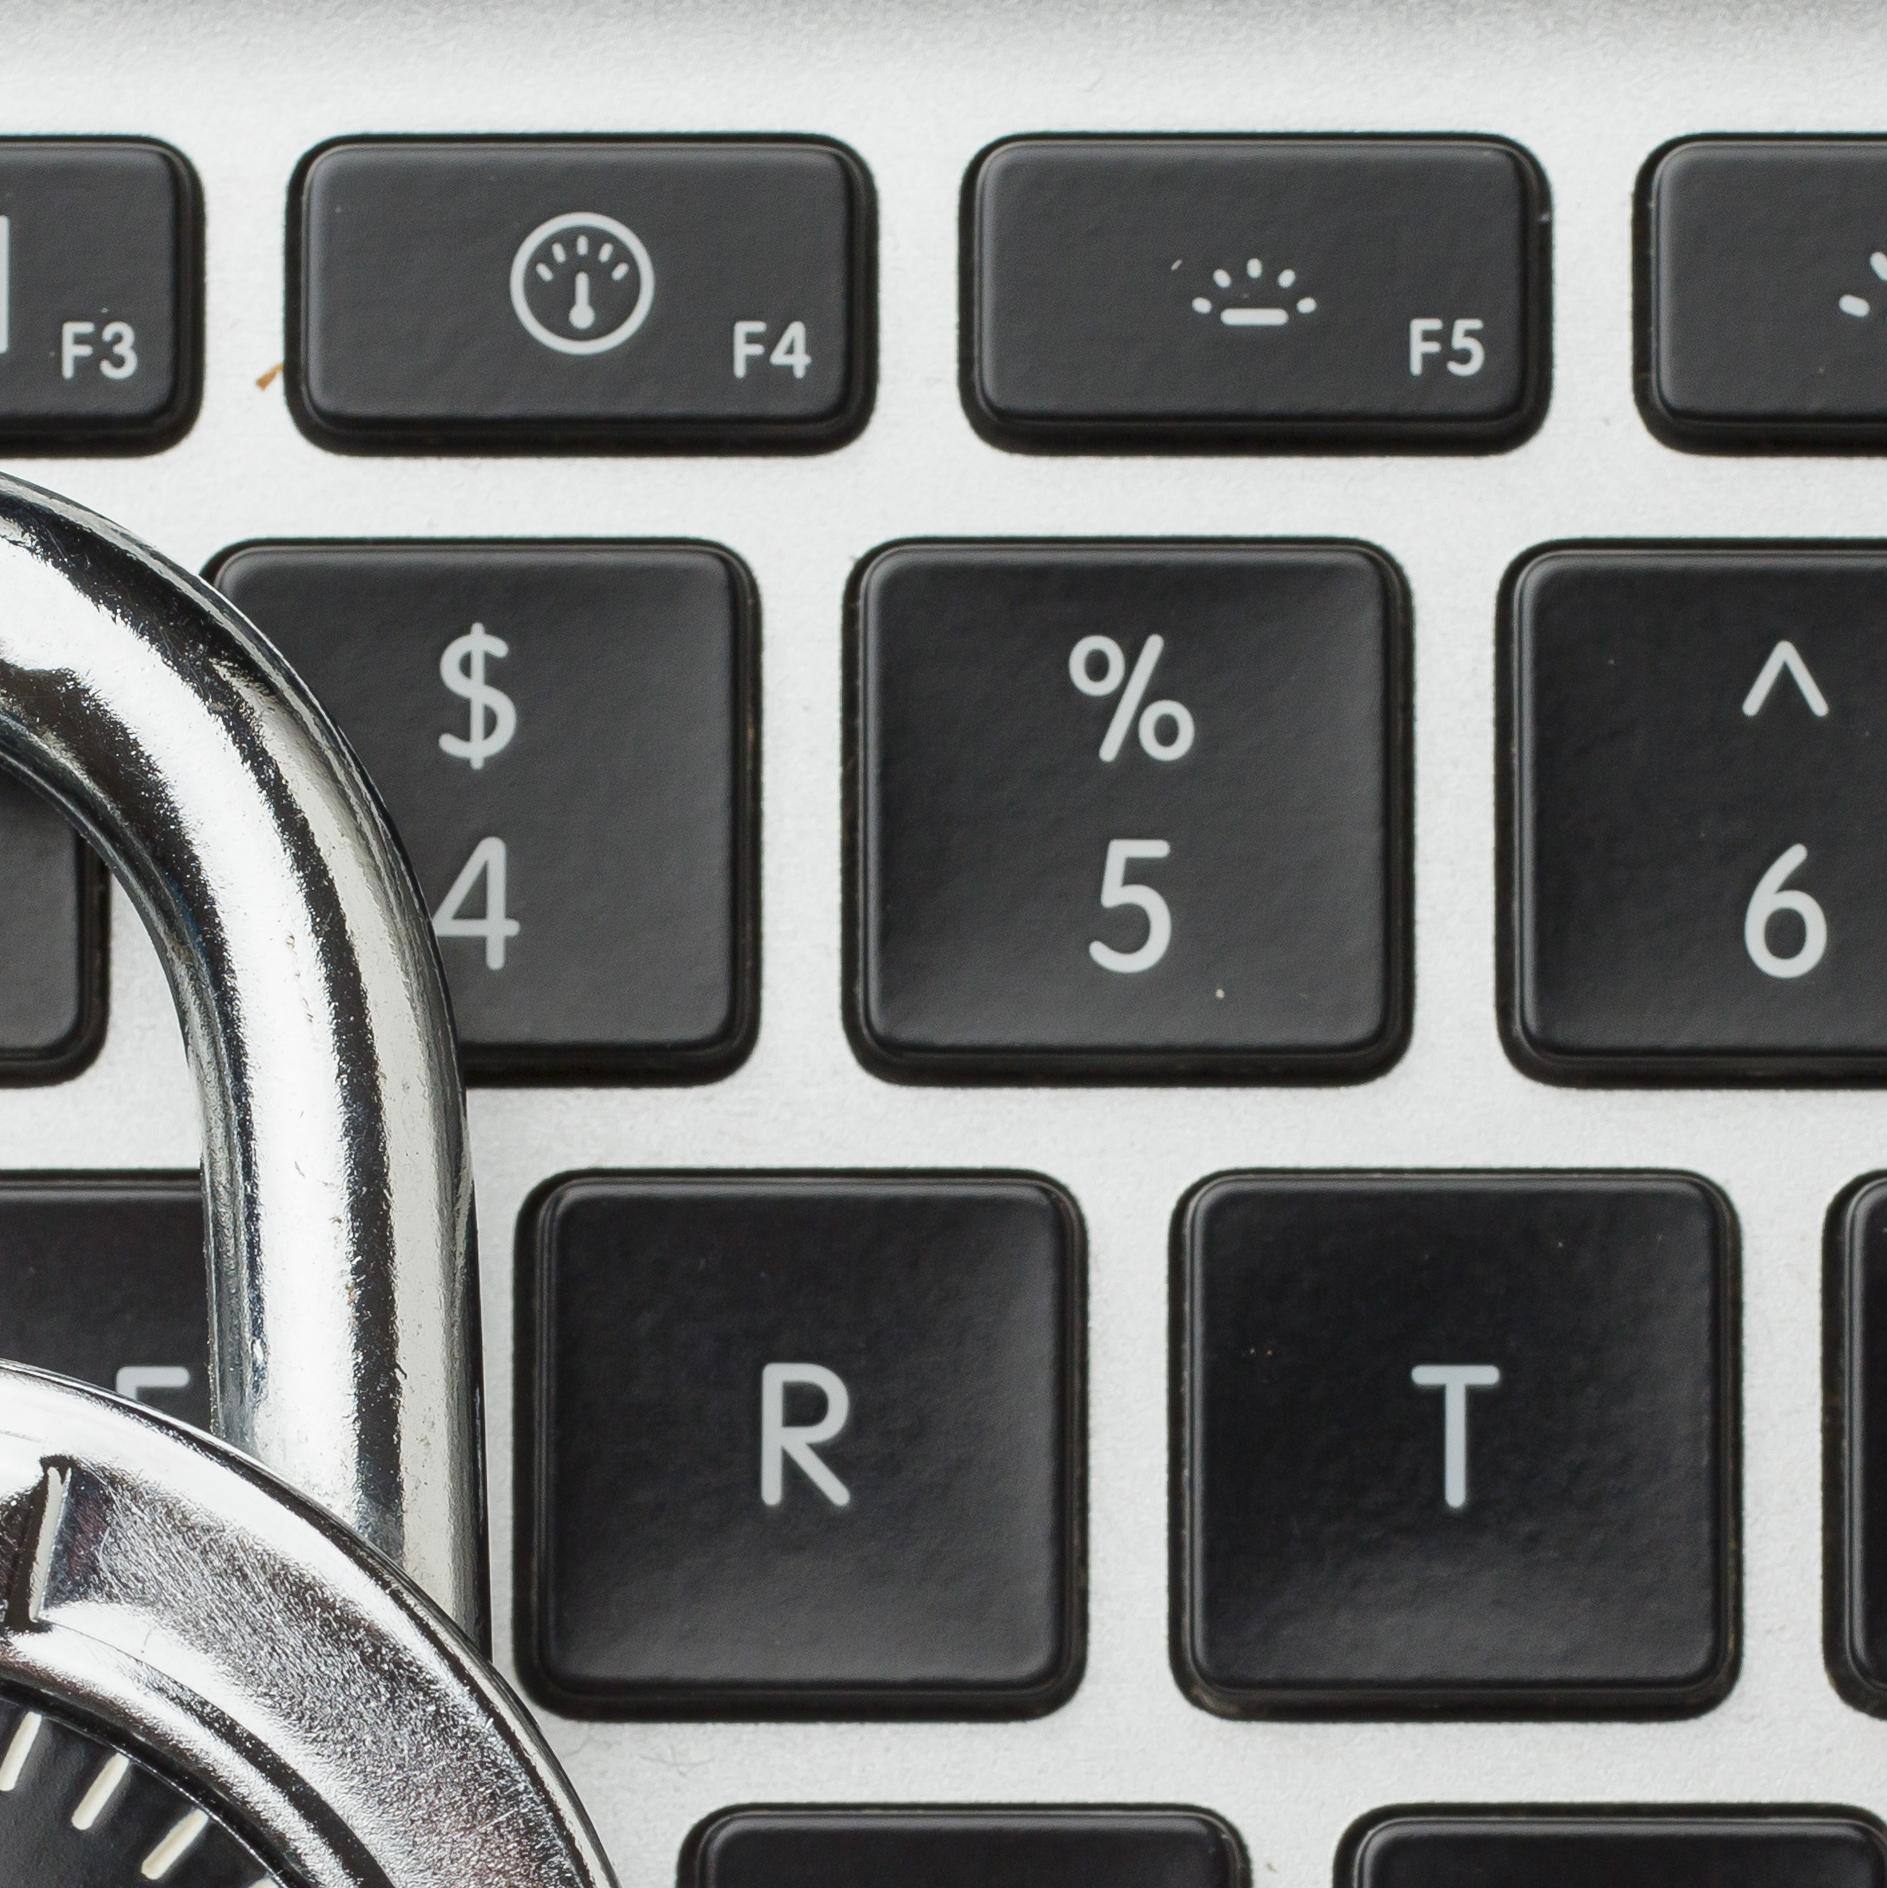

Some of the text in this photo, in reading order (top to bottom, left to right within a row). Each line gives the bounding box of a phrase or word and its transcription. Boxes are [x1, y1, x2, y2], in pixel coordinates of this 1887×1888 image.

[61, 321, 138, 380] F3
[733, 320, 812, 379] F4
[1409, 318, 1485, 377] F5
[438, 622, 518, 770] $
[1068, 633, 1196, 763] %
[1742, 640, 1830, 718] ^
[433, 838, 519, 970] 4
[1088, 839, 1172, 974] 5
[1744, 843, 1828, 979] 6
[760, 1362, 851, 1508] R
[1411, 1364, 1501, 1509] T
